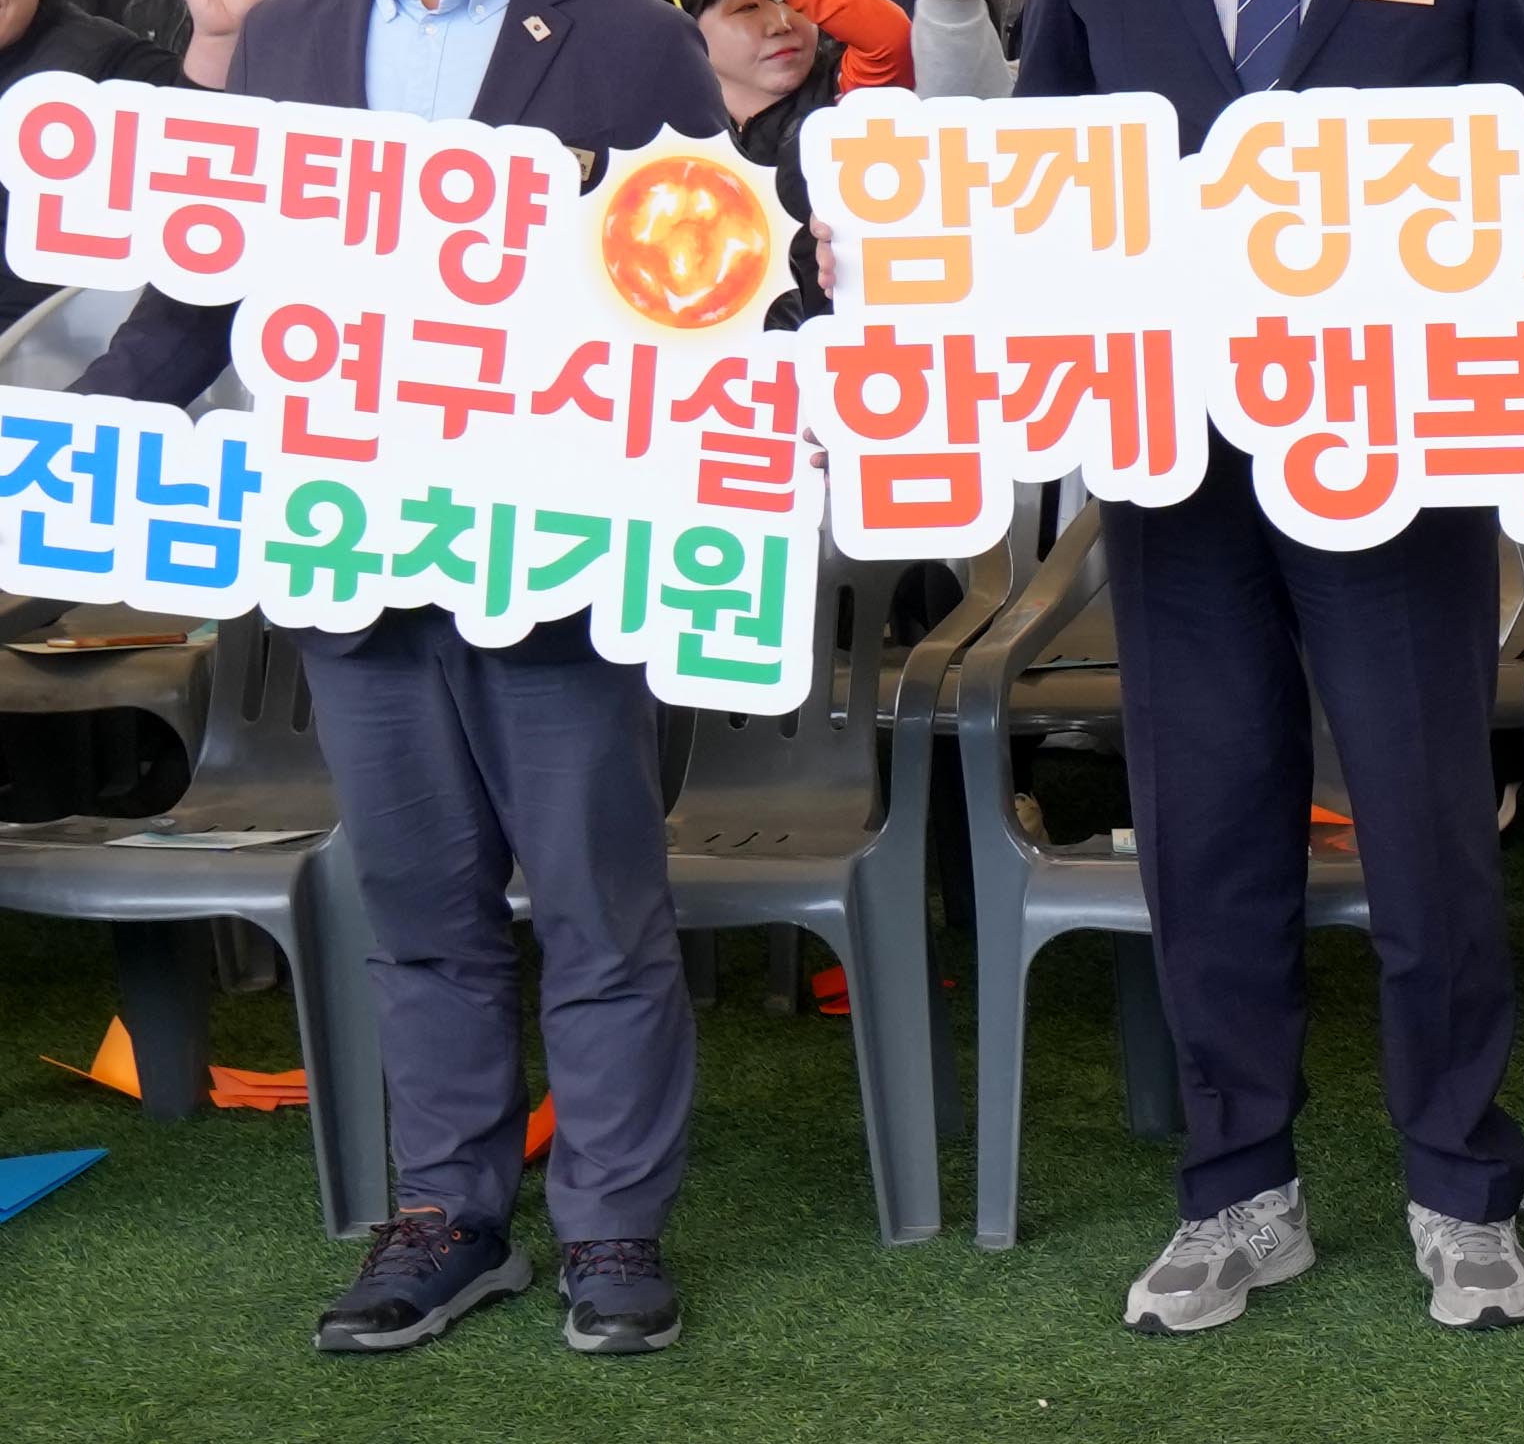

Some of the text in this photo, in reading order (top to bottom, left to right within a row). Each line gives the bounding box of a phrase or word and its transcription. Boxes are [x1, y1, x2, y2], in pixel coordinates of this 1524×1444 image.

[18, 102, 550, 305] 인공태양
[831, 119, 1151, 306] 함께
[261, 303, 798, 513] 연구시설
[825, 324, 1178, 530] 함께
[0, 415, 789, 686] 전남 유치기원
